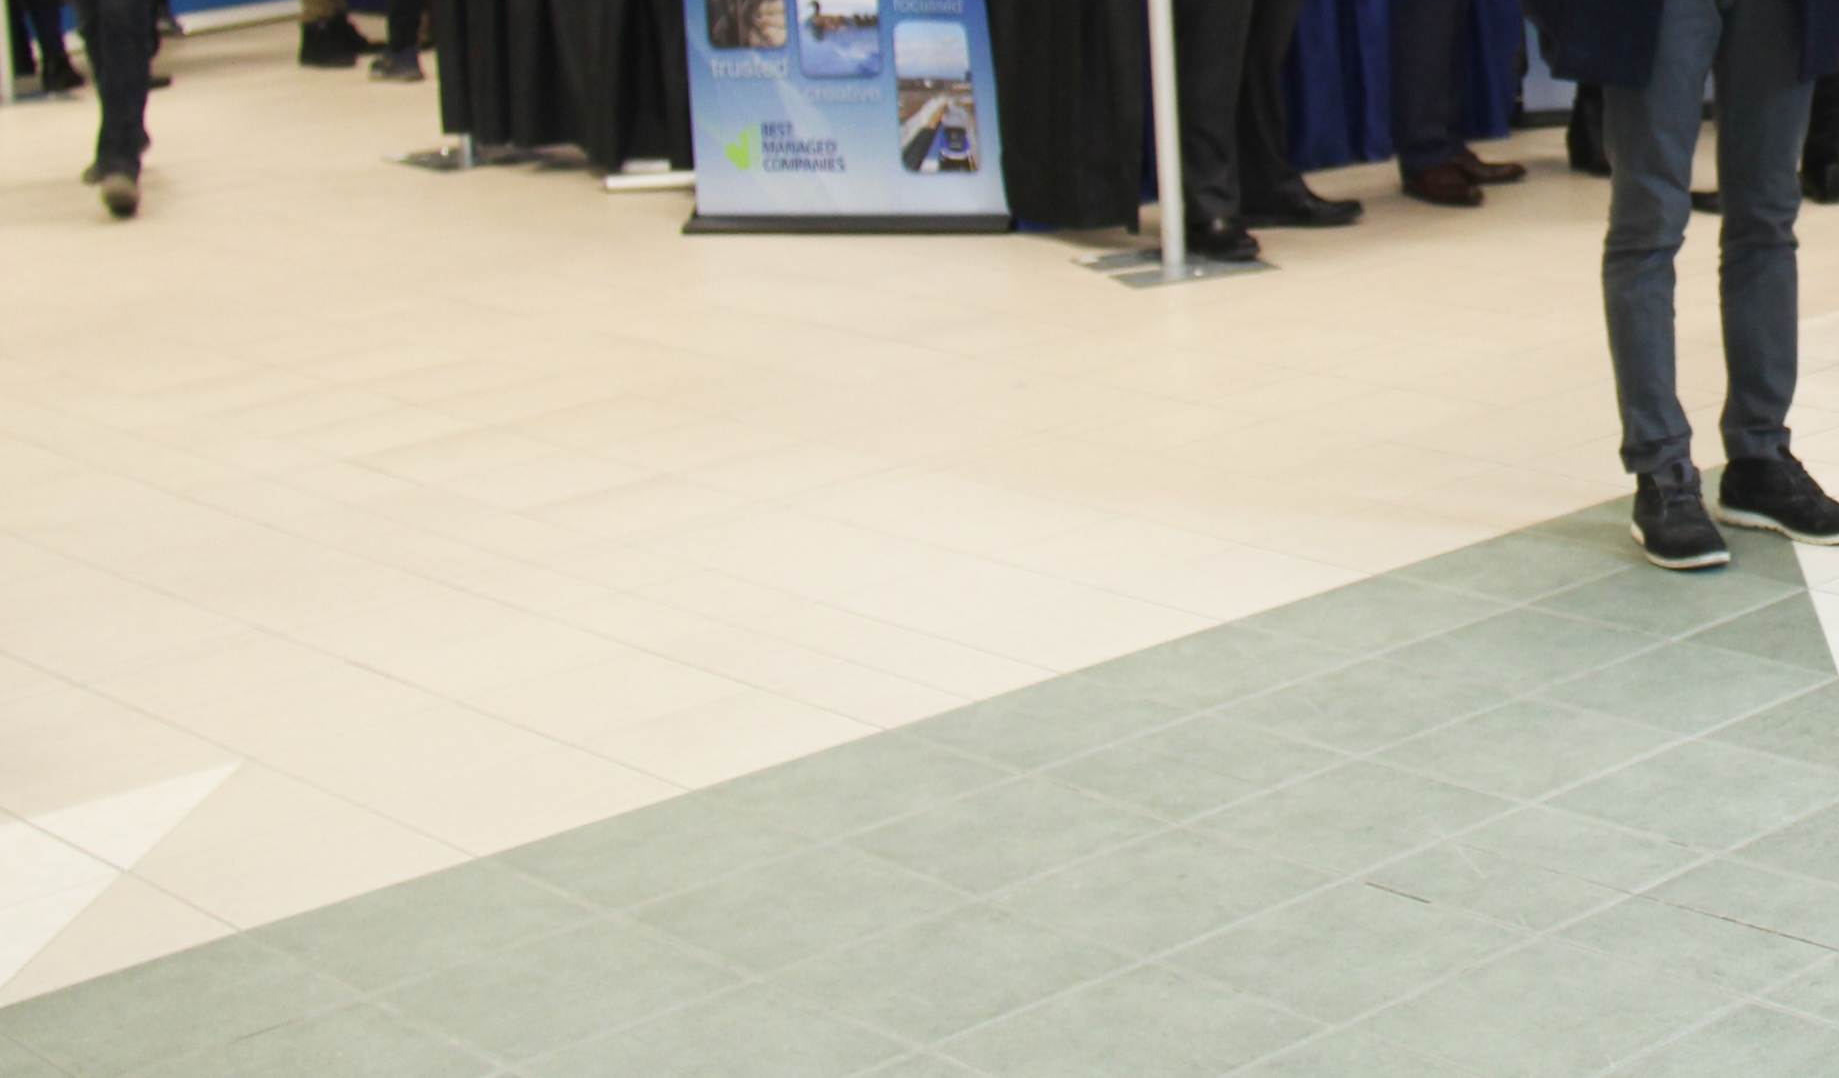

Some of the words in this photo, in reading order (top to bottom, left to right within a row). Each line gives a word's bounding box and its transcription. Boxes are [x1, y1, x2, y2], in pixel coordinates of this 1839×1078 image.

[761, 121, 793, 137] BEST
[762, 139, 838, 154] MANAGED
[762, 157, 847, 172] COMPANIES
